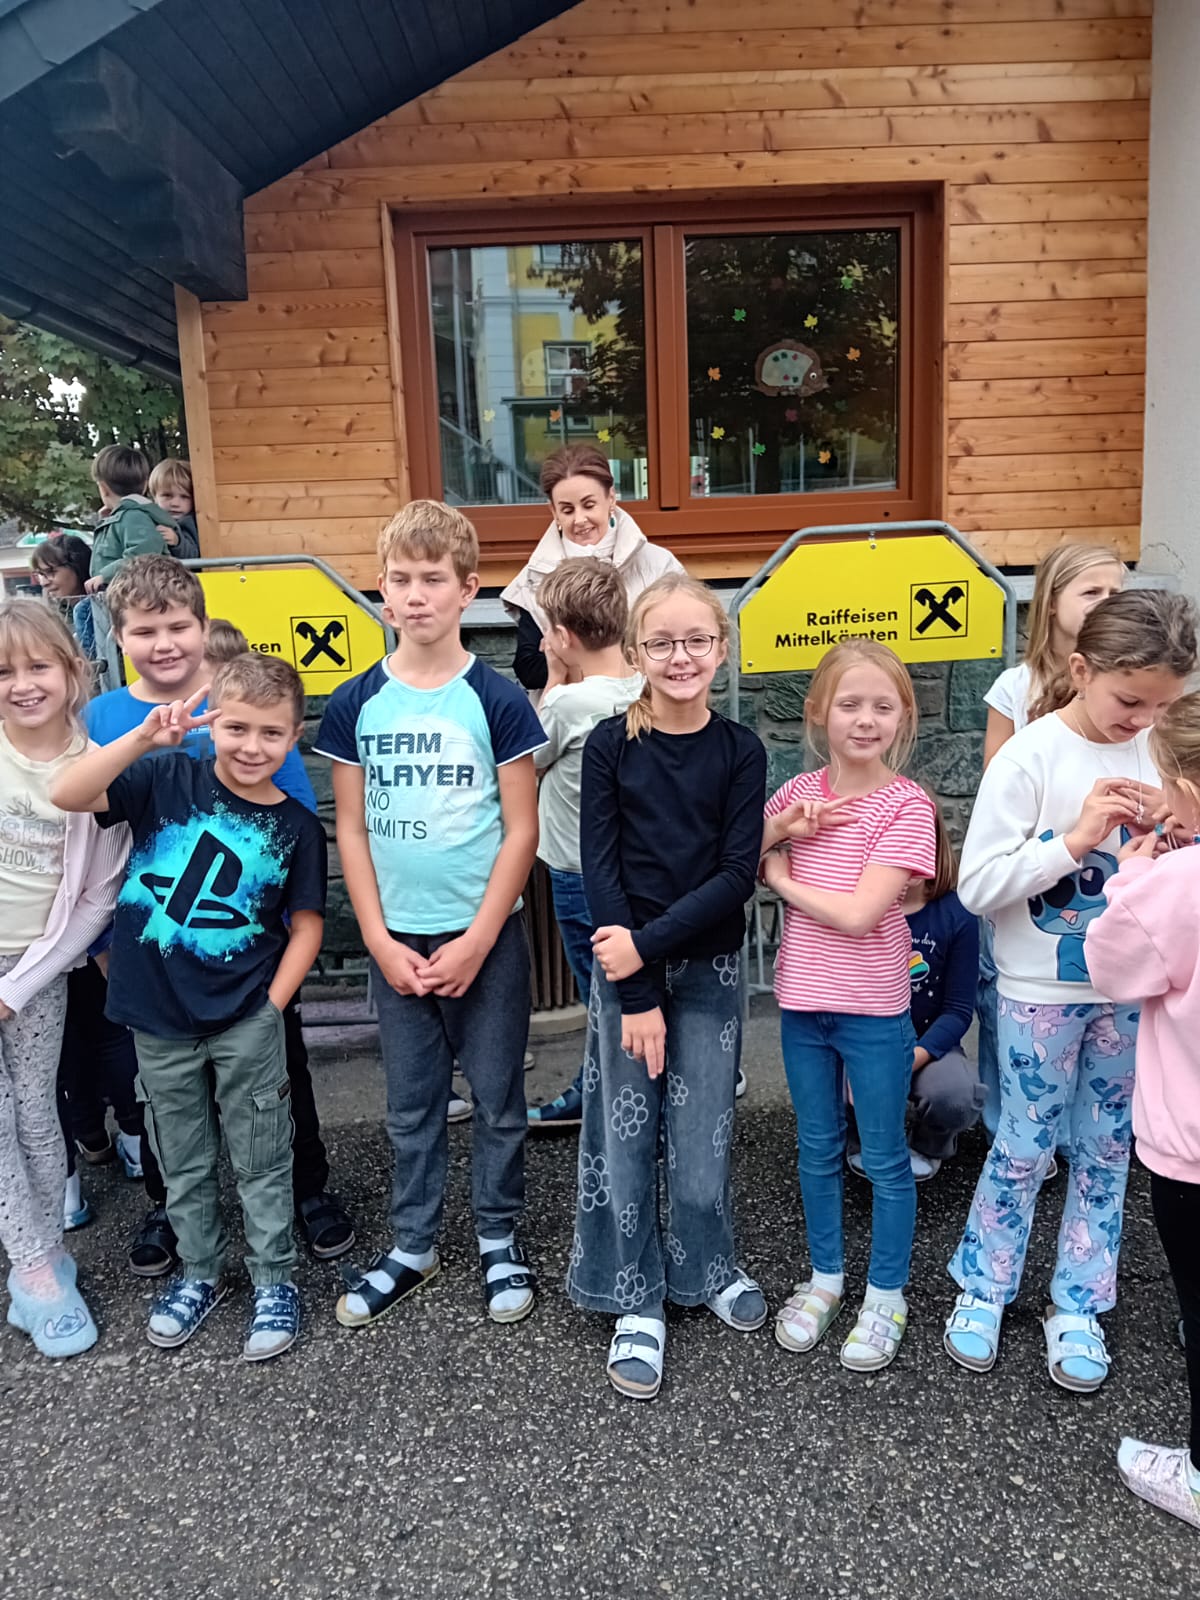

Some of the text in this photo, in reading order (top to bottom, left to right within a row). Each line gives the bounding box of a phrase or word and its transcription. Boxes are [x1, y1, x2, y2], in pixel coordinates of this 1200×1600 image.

[806, 607, 899, 627] Raiffeisen
[360, 732, 443, 756] TEAM
[368, 763, 475, 788] PLAYER
[366, 790, 390, 811] NO
[366, 813, 428, 841] LIMITS
[0, 846, 37, 868] HOW
